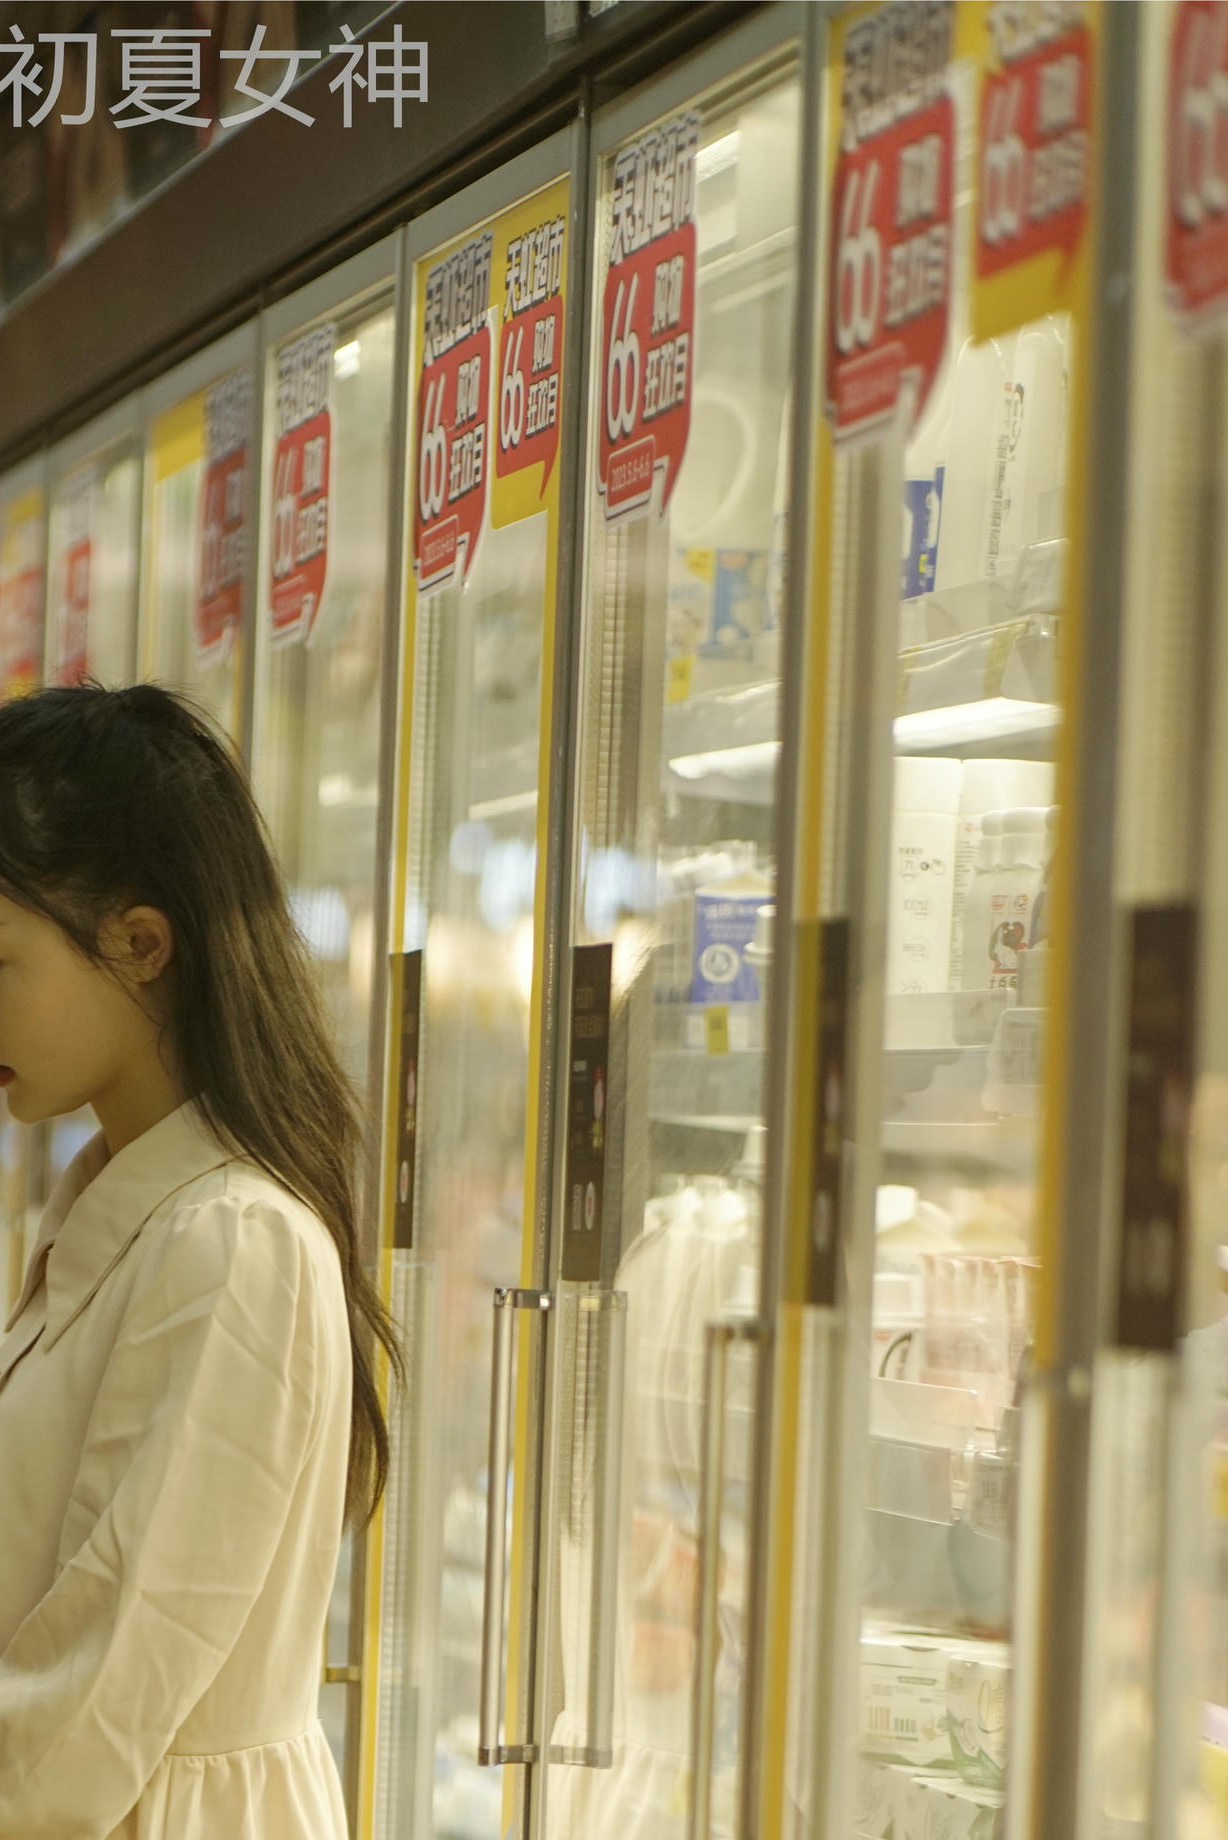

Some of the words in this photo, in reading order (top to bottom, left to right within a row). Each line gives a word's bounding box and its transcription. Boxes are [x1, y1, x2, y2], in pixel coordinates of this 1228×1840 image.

[499, 326, 525, 453] 66
[607, 271, 640, 441] 66
[419, 372, 447, 523] 66
